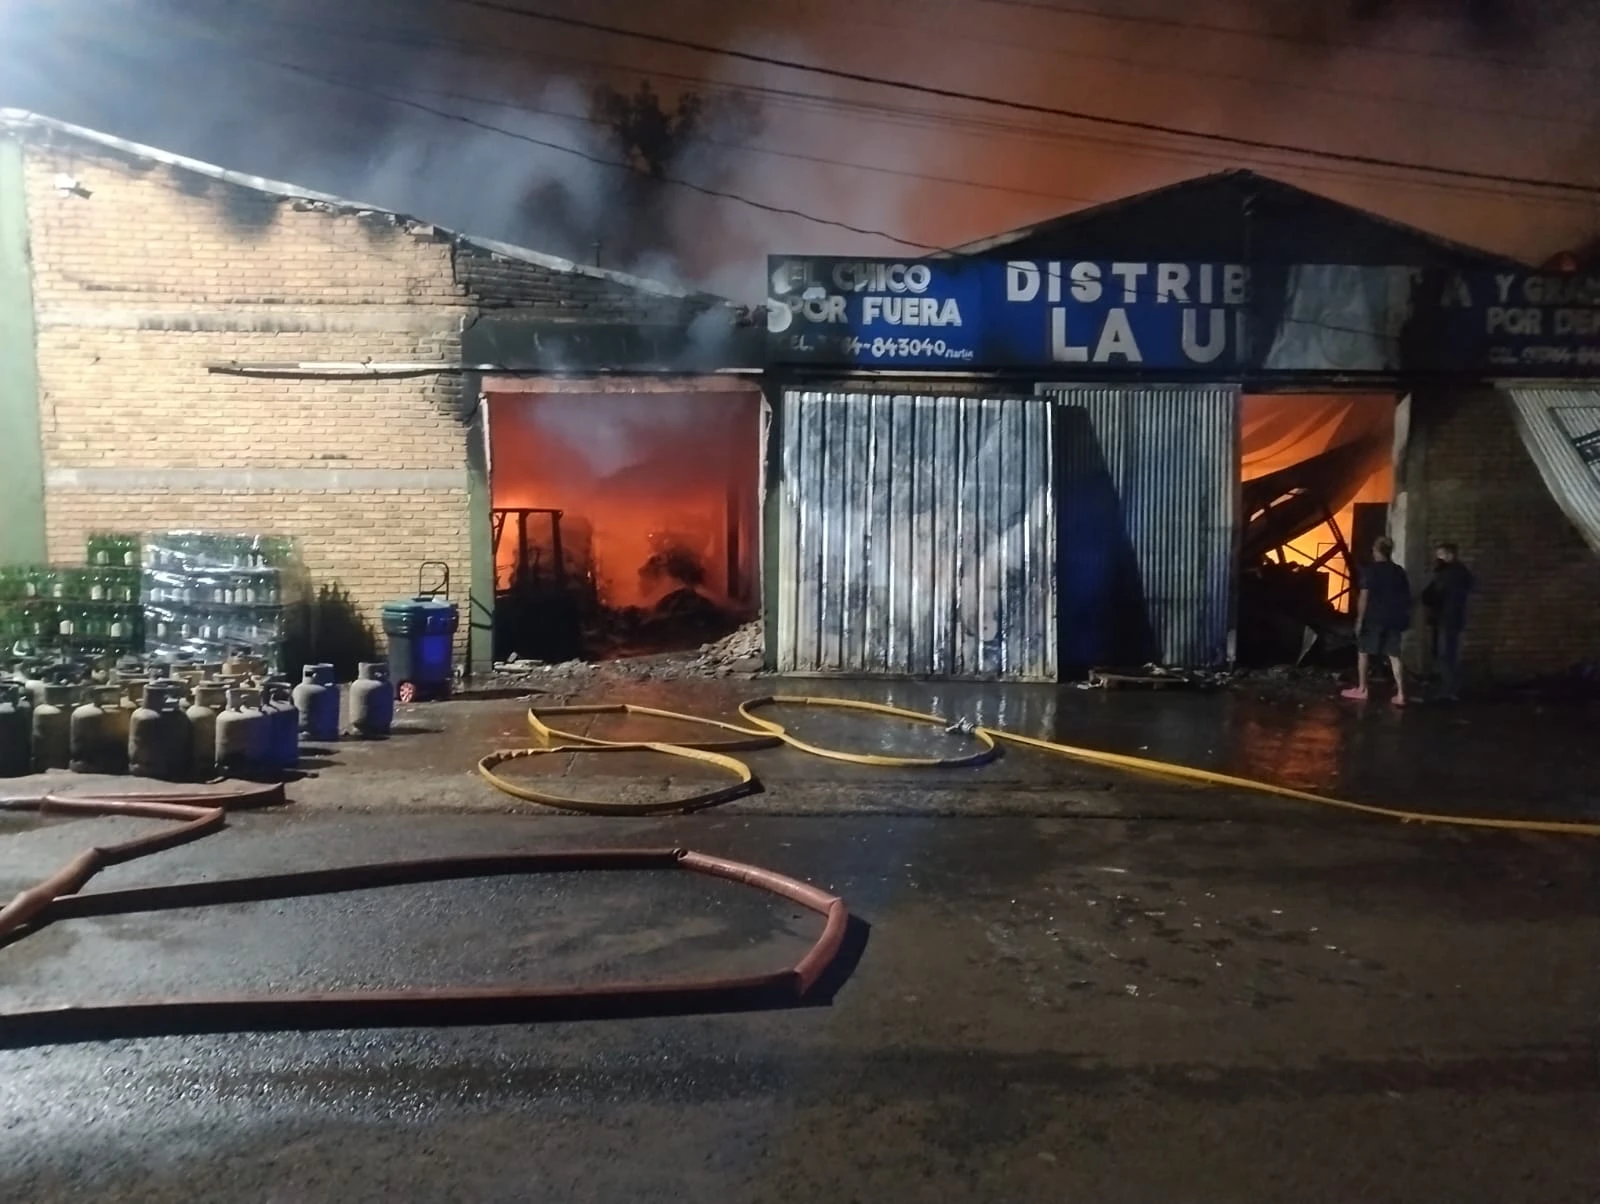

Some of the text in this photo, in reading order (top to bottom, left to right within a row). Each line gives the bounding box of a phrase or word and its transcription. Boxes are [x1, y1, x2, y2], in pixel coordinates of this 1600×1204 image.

[831, 262, 932, 294] CHICO
[785, 296, 963, 327] POR FUERA
[1485, 306, 1542, 336] POR
[1051, 307, 1144, 363] LA
